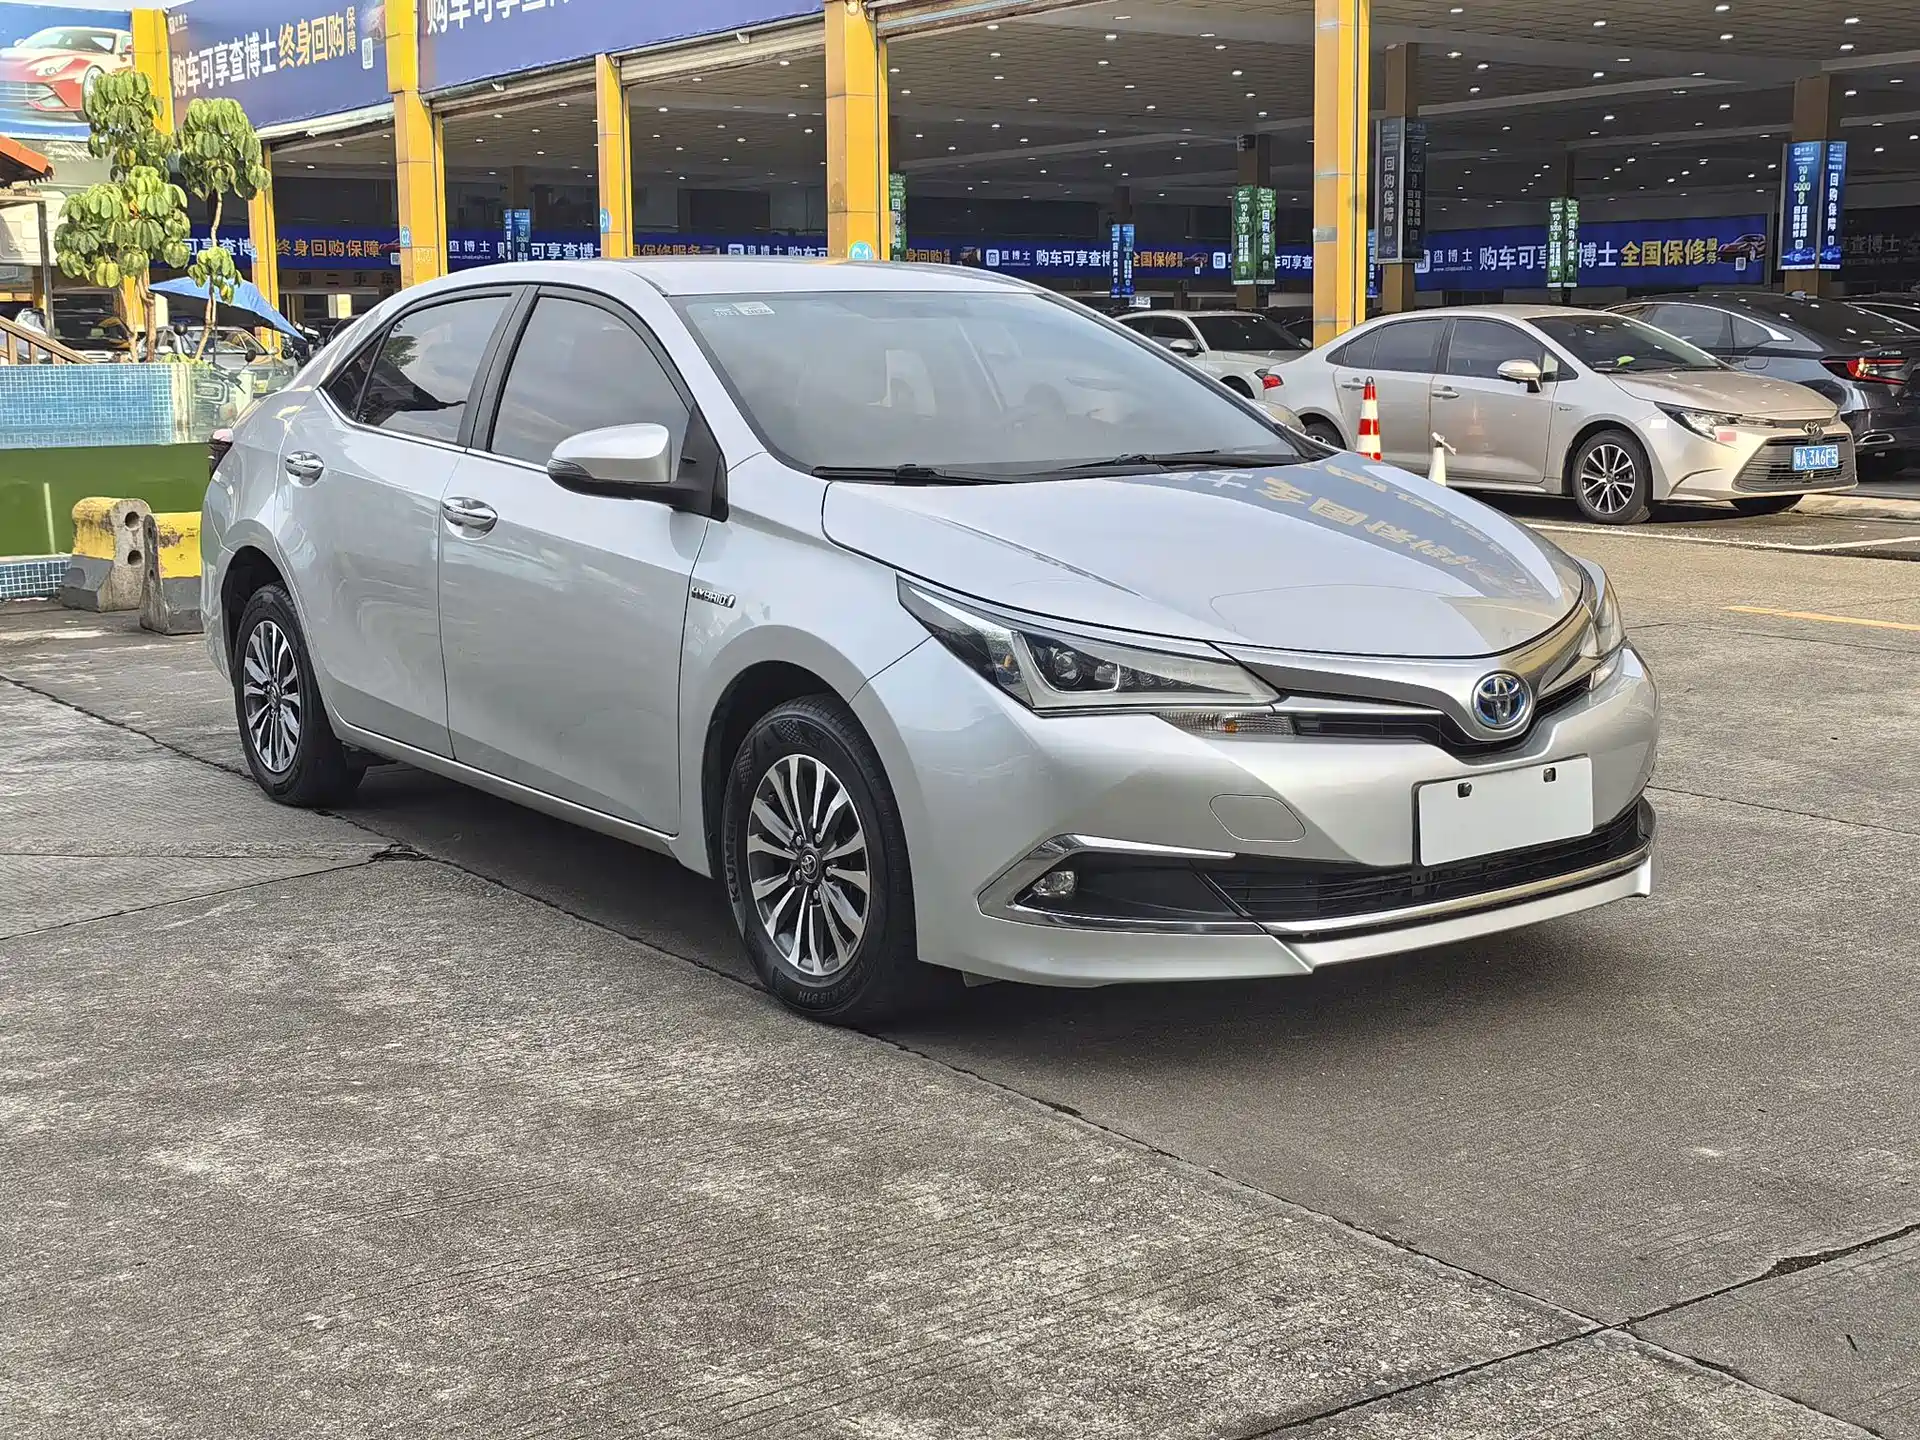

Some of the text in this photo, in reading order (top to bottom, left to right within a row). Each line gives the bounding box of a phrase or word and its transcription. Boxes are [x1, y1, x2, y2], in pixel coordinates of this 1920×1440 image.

[1383, 156, 1395, 223] 回购保障
[277, 239, 381, 258] 终身回购保障
